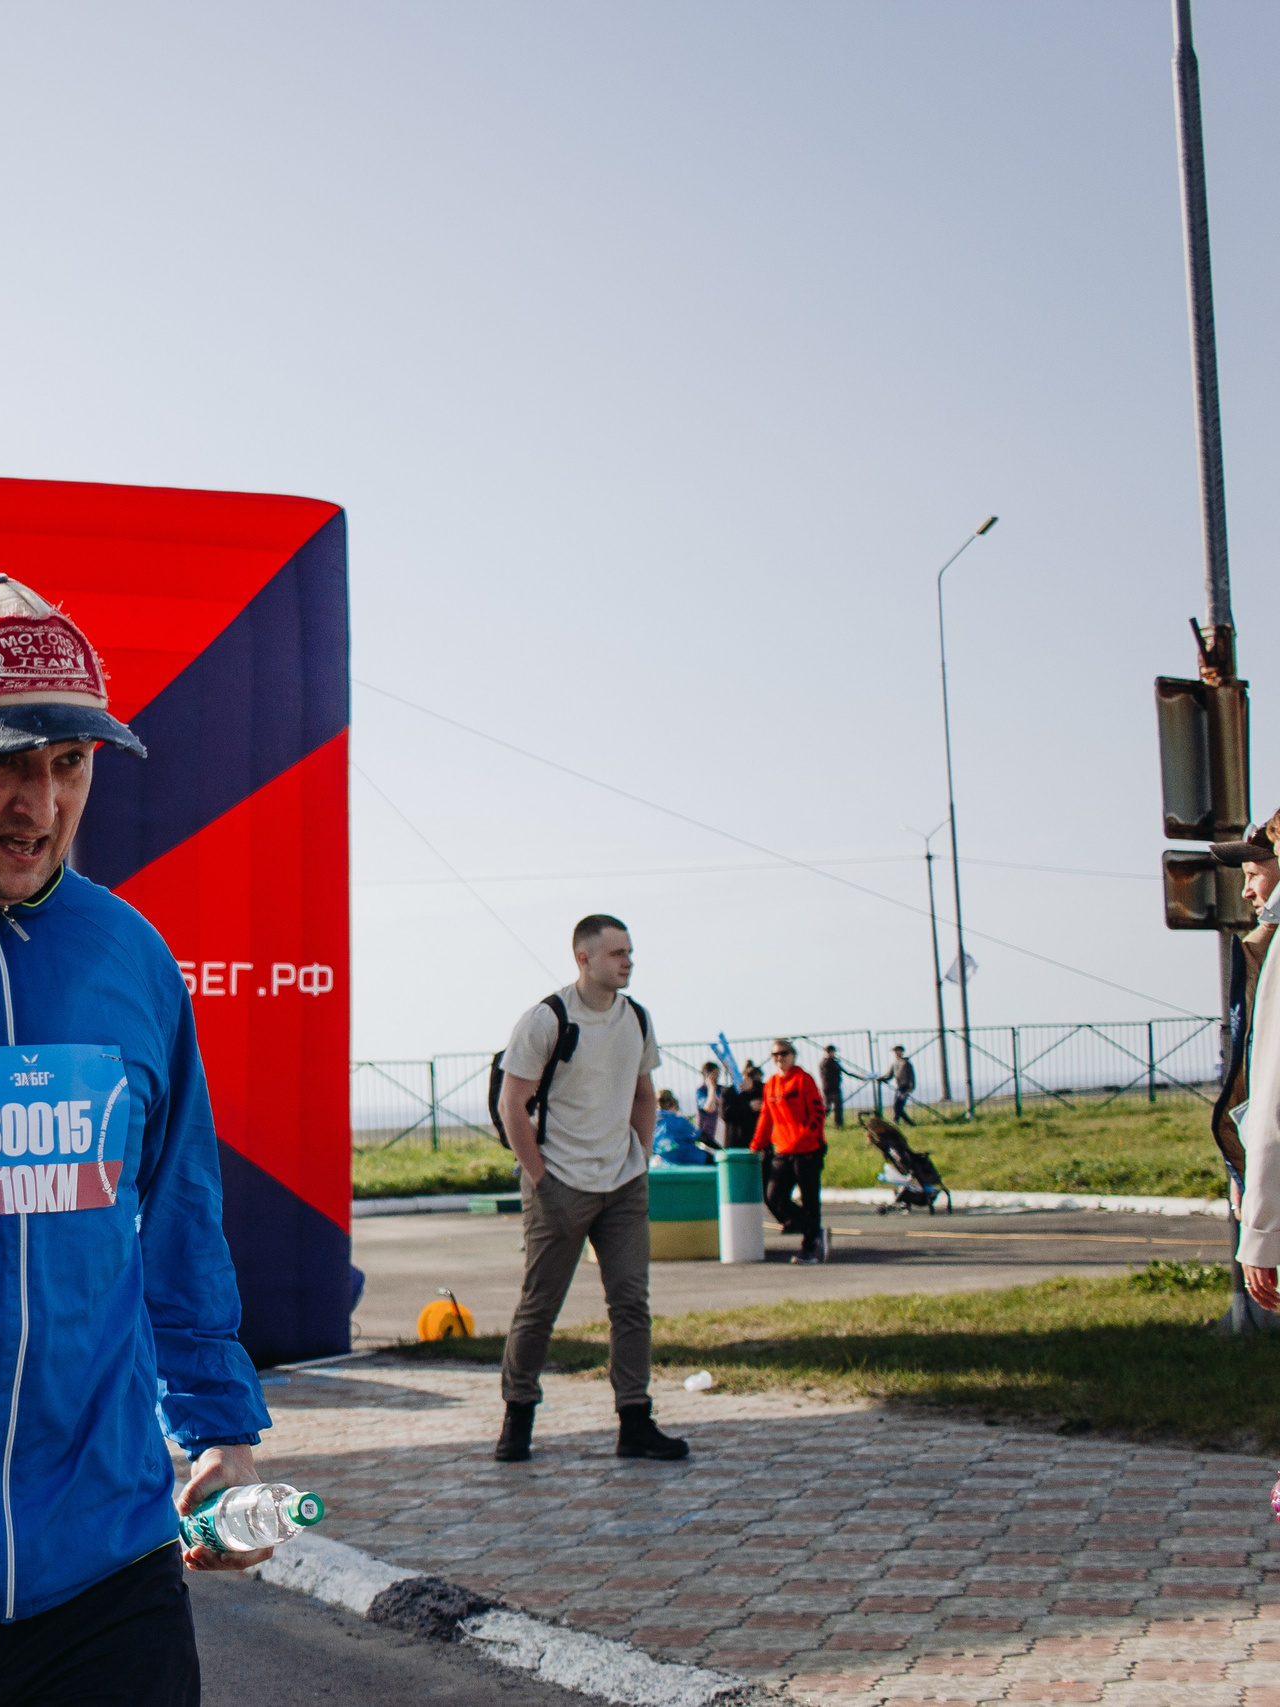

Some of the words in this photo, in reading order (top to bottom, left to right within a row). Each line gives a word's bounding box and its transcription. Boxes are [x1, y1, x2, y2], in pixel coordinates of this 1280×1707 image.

[0, 632, 75, 650] MOTORS
[11, 644, 75, 659] RACING
[19, 657, 74, 669] TEAM
